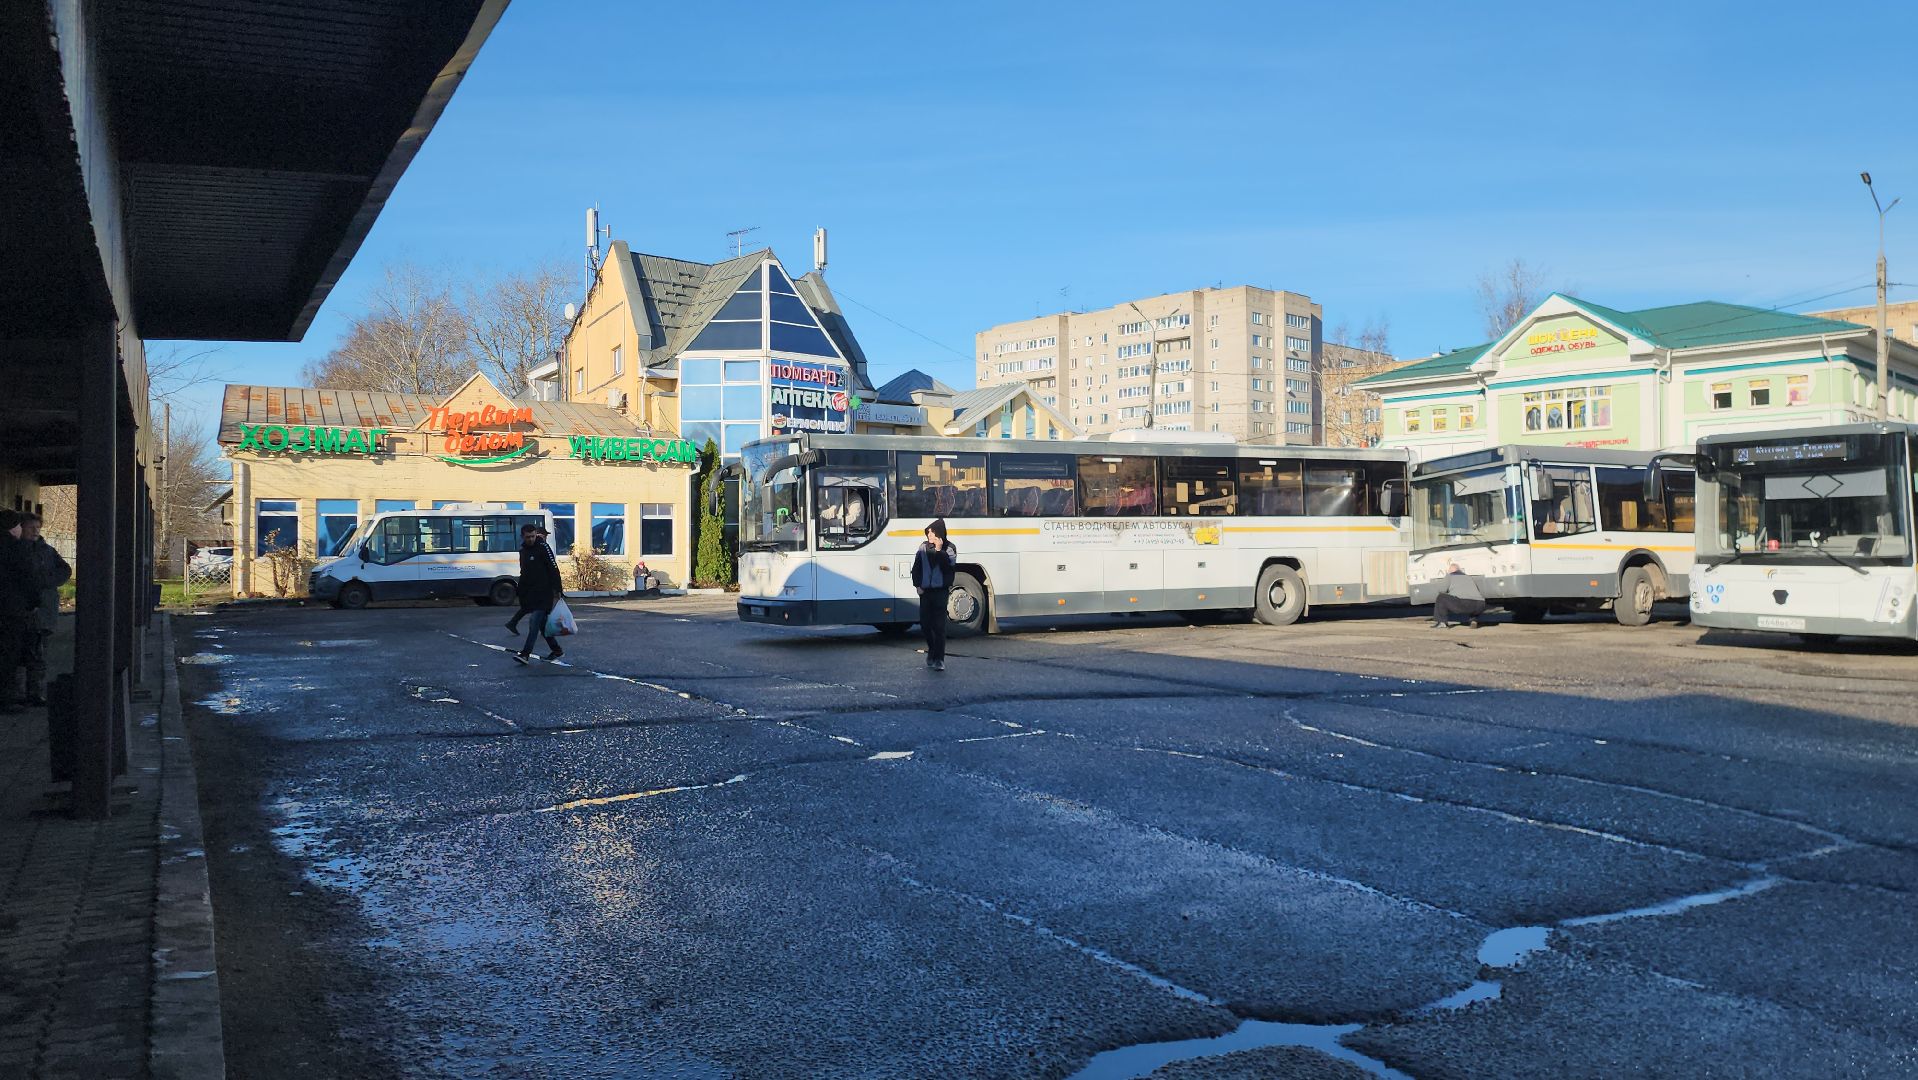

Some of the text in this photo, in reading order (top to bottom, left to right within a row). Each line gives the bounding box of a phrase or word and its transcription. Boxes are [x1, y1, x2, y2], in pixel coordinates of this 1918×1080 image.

[1530, 340, 1596, 355] ОДЕЖДА ОБУВЬ
[771, 364, 836, 387] ЛОМБАРД
[772, 387, 833, 410] АПТЕКА
[427, 404, 533, 434] Первым
[787, 417, 847, 432] ЕРМОЛИНО
[239, 422, 388, 454] ХОЗМАГ
[444, 429, 523, 453] делом
[567, 435, 697, 463] УНИВЕРСАМ
[1043, 521, 1075, 531] СТАНЬ
[1078, 521, 1140, 531] ВОДИТЕЛЕМ
